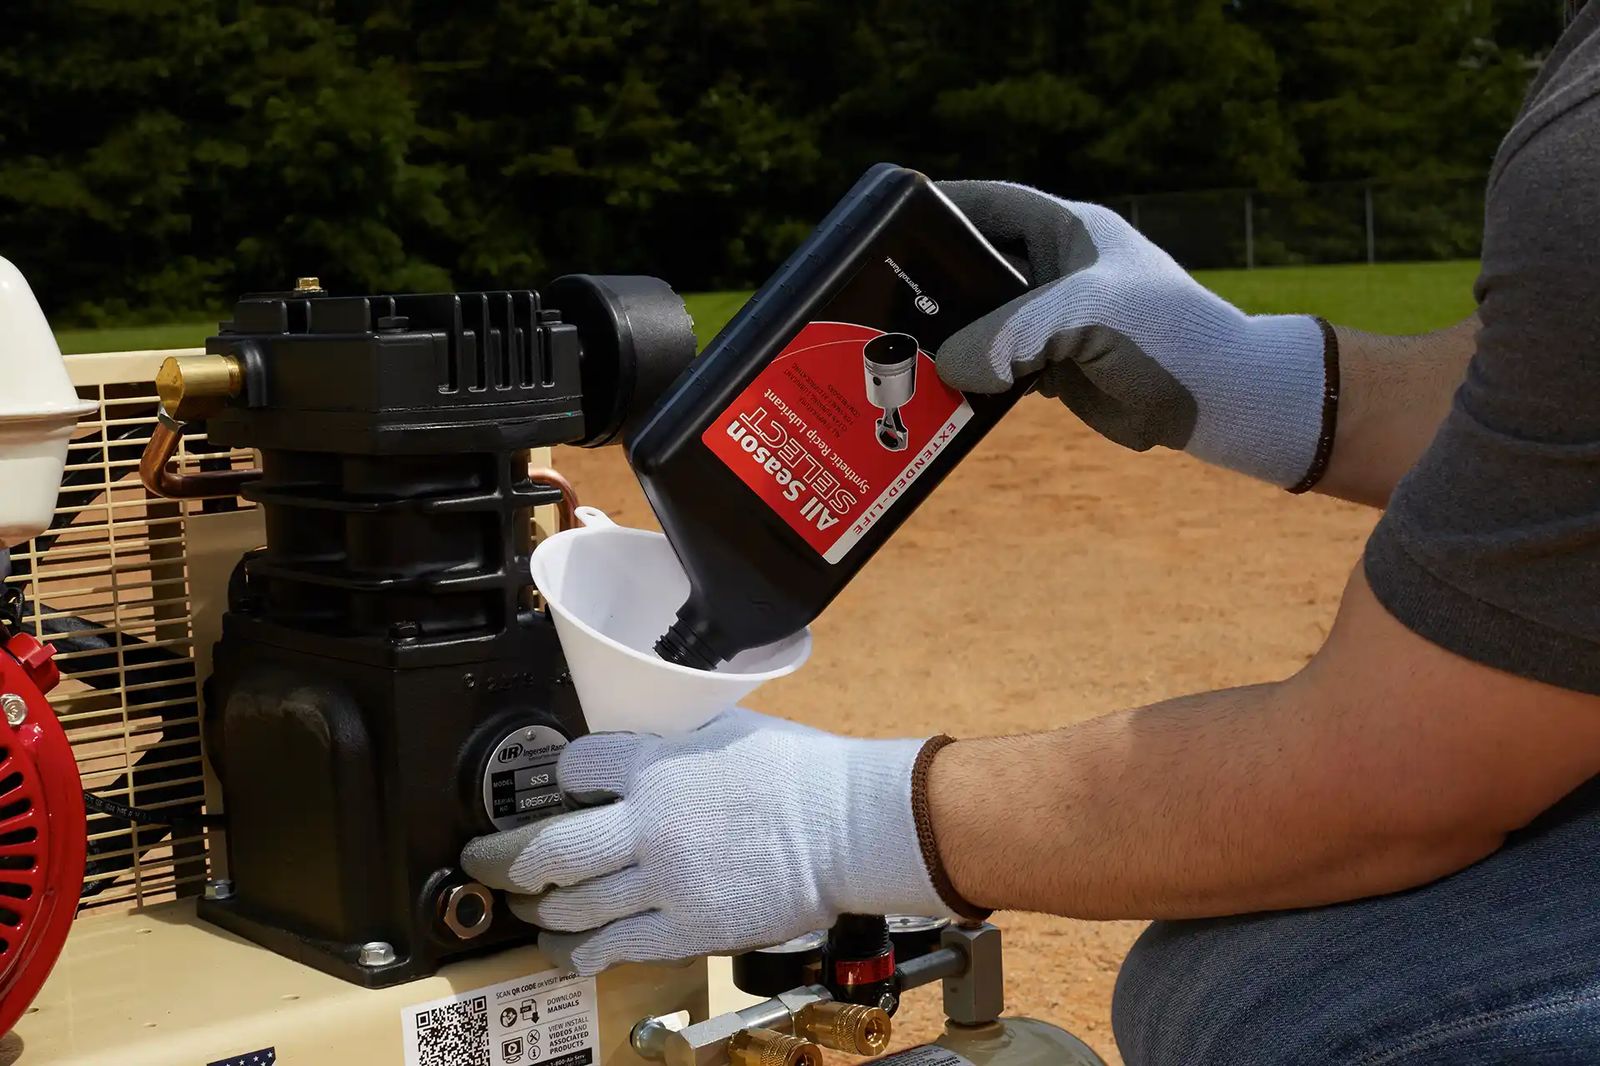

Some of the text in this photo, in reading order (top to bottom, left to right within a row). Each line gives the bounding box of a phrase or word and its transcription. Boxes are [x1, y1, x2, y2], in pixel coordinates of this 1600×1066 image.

[898, 271, 922, 295] Ingersoll
[916, 296, 938, 315] IR
[764, 388, 870, 494] Synthetic Recip Lubricant
[739, 406, 858, 515] SELECT
[726, 420, 840, 531] All Season
[853, 422, 957, 535] EXTENDED-LIFE
[500, 744, 521, 762] IR
[523, 745, 550, 757] Ingersoll
[530, 773, 549, 786] SS3
[520, 792, 562, 809] 1056779
[495, 990, 511, 1000] SCAN
[512, 987, 521, 996] QR
[521, 982, 537, 993] CODE
[546, 991, 582, 1006] DOWNLOAD
[547, 1000, 580, 1014] MANUALS
[548, 1017, 589, 1032] VIEW INSTALL
[549, 1024, 588, 1040] VIDEOS AND
[550, 1031, 589, 1047] ASSOCIATED
[550, 1040, 584, 1055] PRODUCTS
